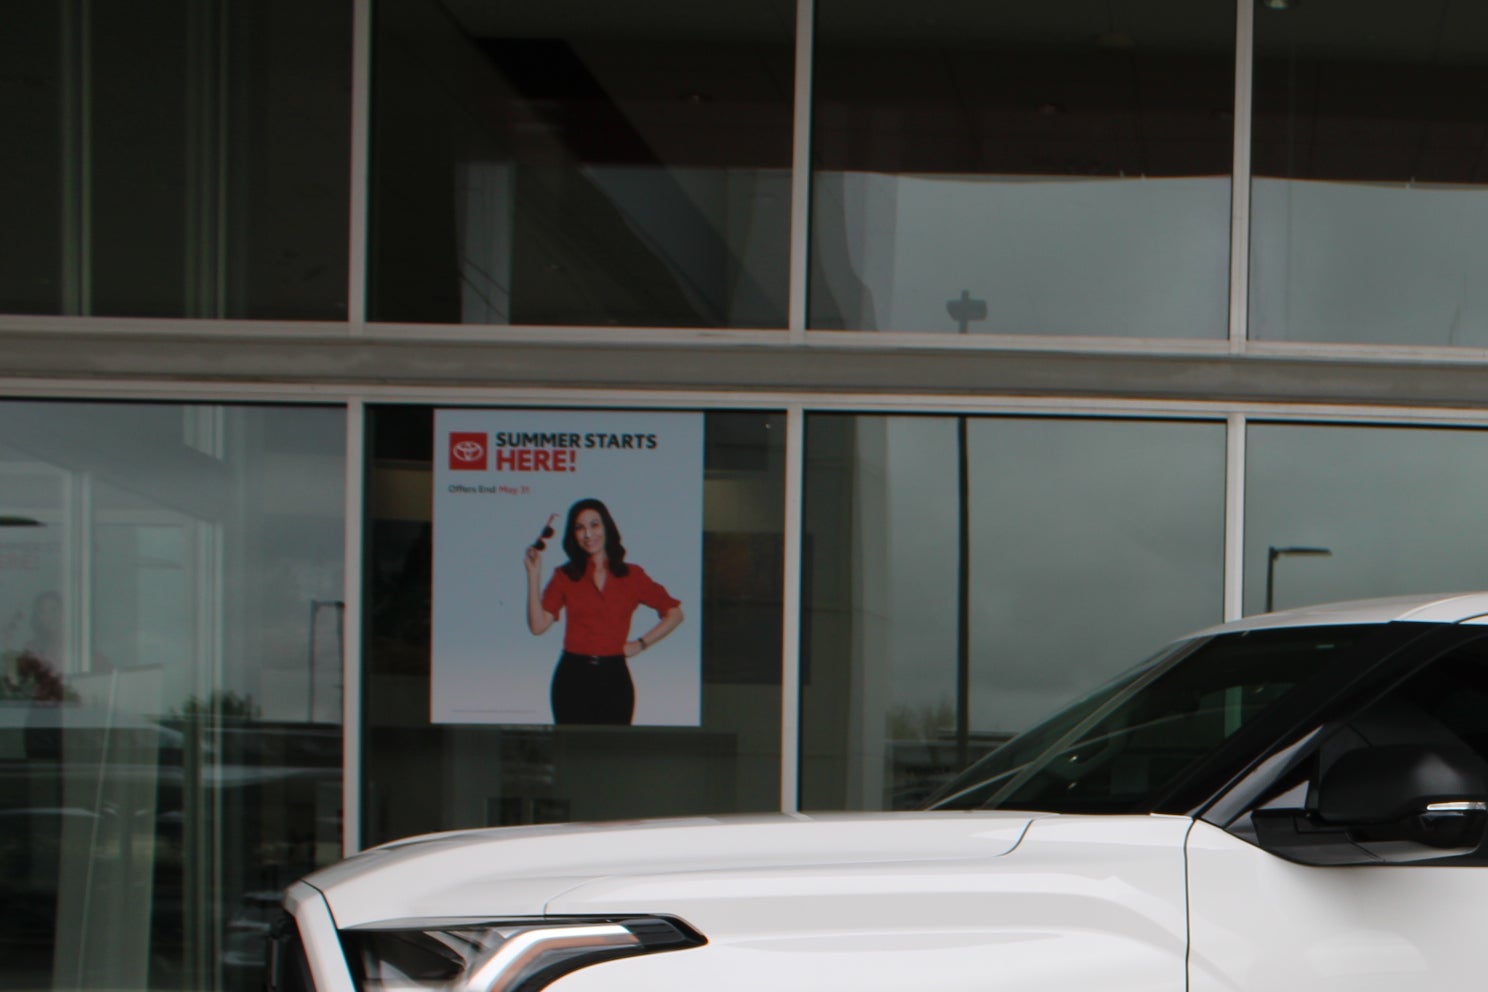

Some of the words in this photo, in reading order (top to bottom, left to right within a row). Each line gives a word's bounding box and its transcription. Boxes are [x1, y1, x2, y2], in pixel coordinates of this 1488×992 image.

[495, 432, 580, 448] SUMMER
[586, 433, 657, 449] STARTS
[496, 449, 576, 472] HERE!
[448, 484, 477, 494] Offers
[478, 485, 496, 494] End
